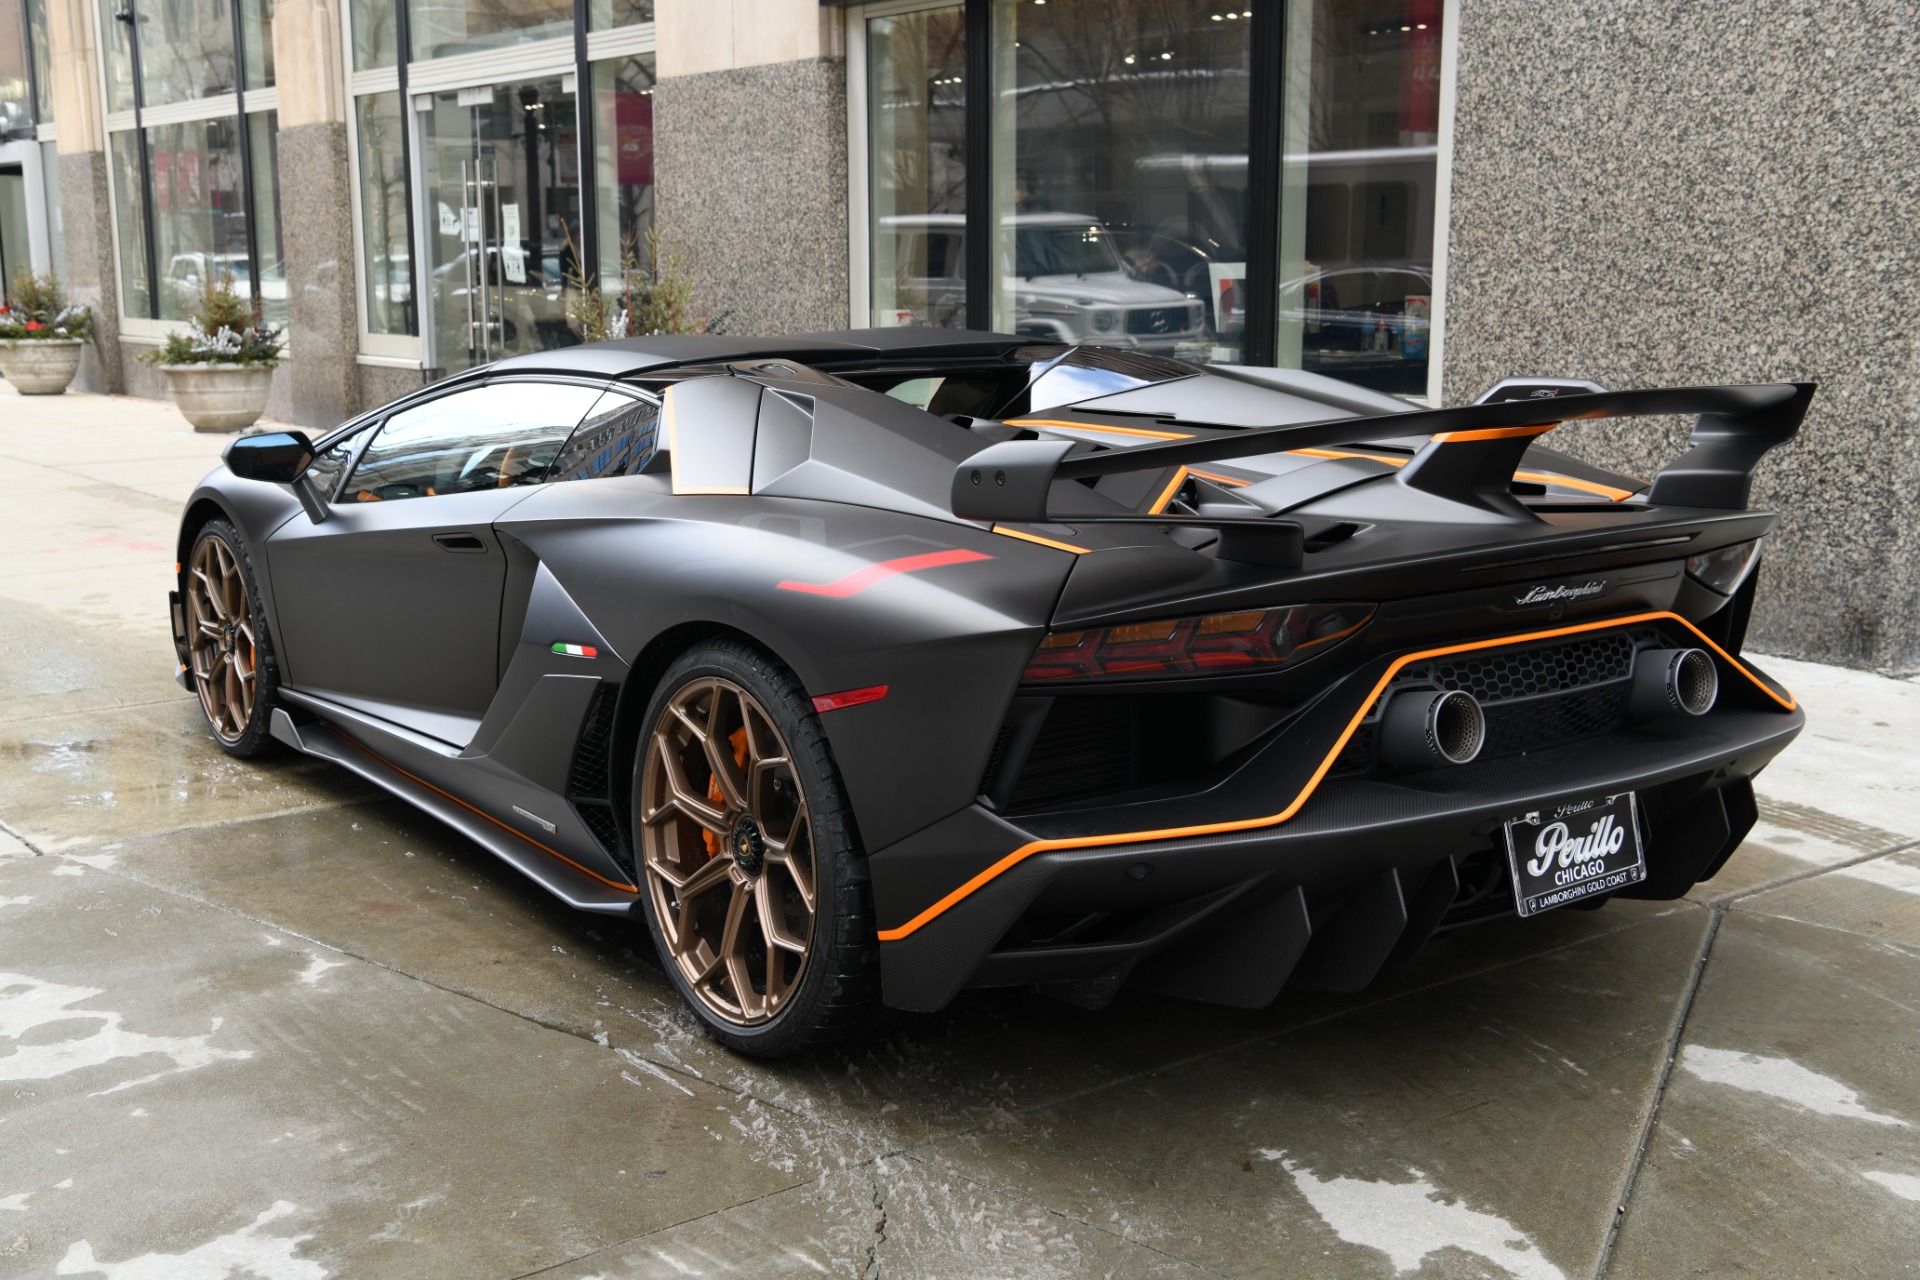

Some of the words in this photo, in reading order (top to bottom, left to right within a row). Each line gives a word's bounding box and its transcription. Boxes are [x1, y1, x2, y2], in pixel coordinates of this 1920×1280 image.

[1516, 580, 1606, 605] Lamborghini
[1554, 800, 1594, 818] Perillo
[1527, 814, 1624, 877] Perillo
[1554, 859, 1605, 885] CHICAGO
[1540, 886, 1587, 908] LAMBORGHINI
[1586, 879, 1606, 893] GOLD
[1606, 872, 1627, 887] COAST
